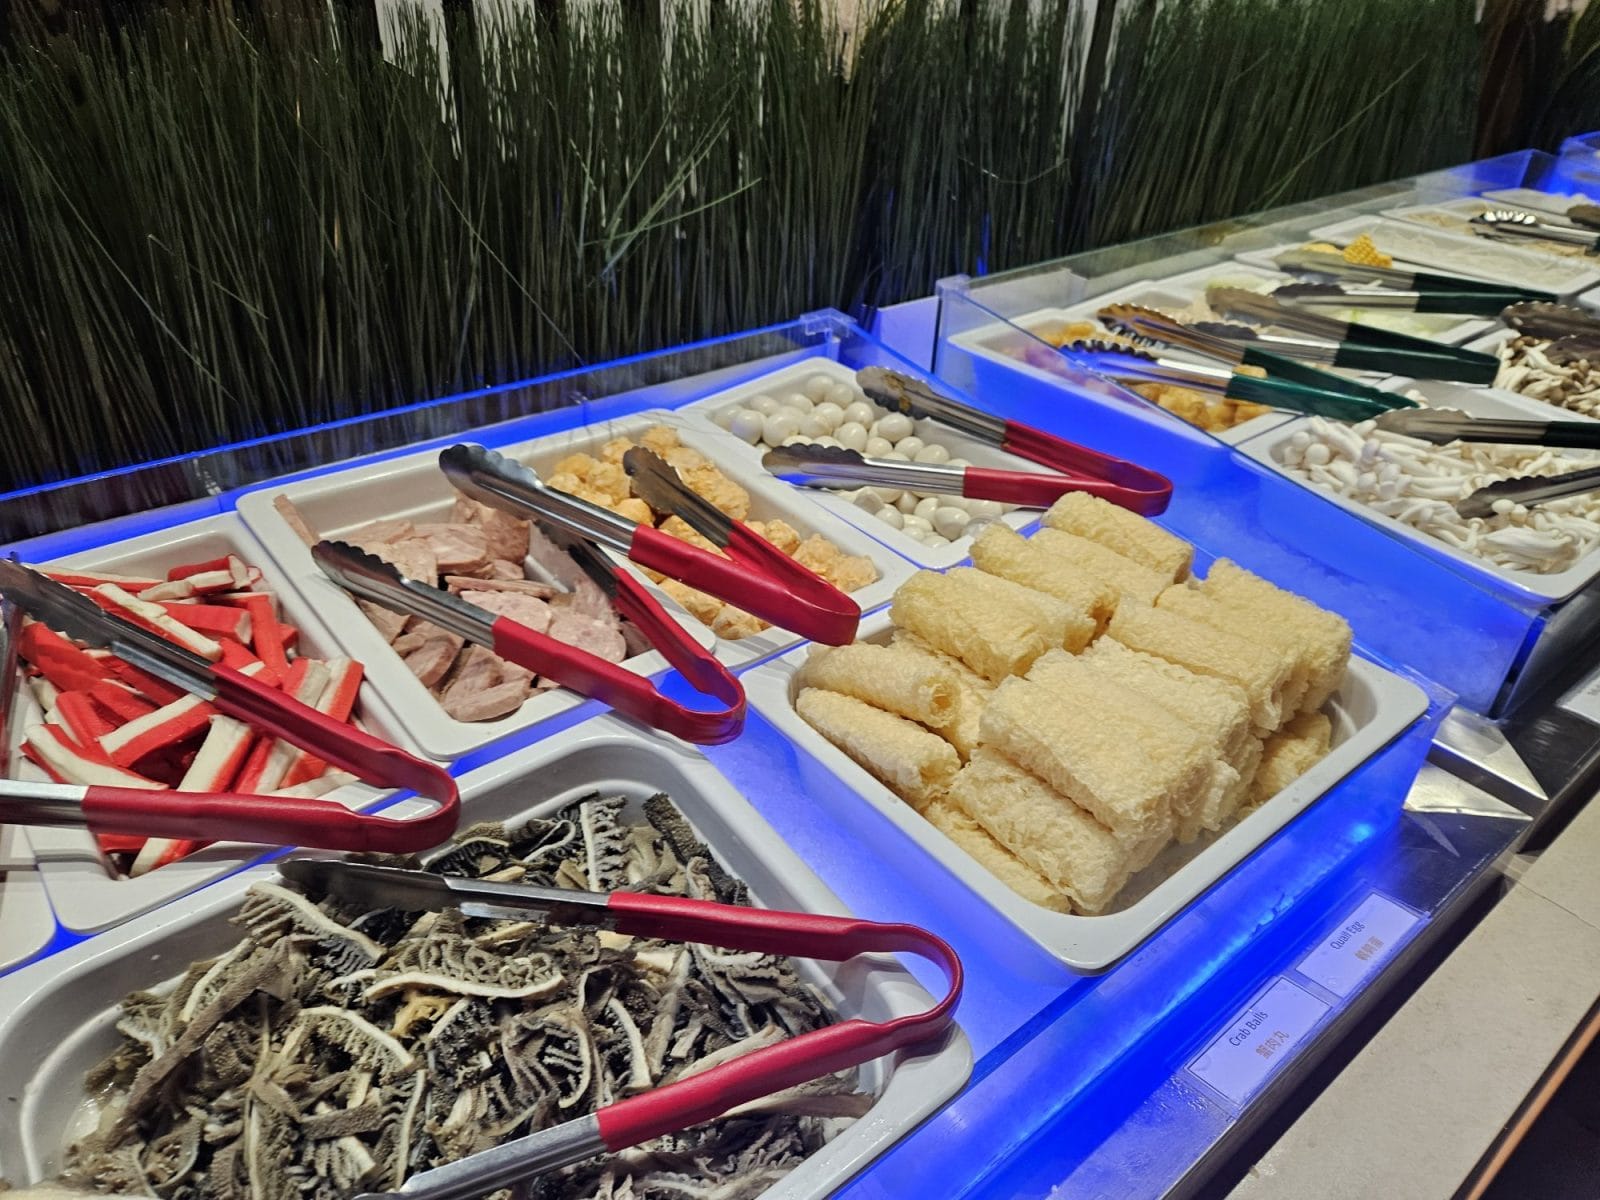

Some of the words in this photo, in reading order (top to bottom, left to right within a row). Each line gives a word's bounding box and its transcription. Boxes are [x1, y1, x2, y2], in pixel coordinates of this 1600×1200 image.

[1330, 930, 1351, 950] Quail
[1346, 921, 1366, 933] Egg
[1228, 1028, 1250, 1047] Crab
[1246, 1011, 1268, 1031] Balls
